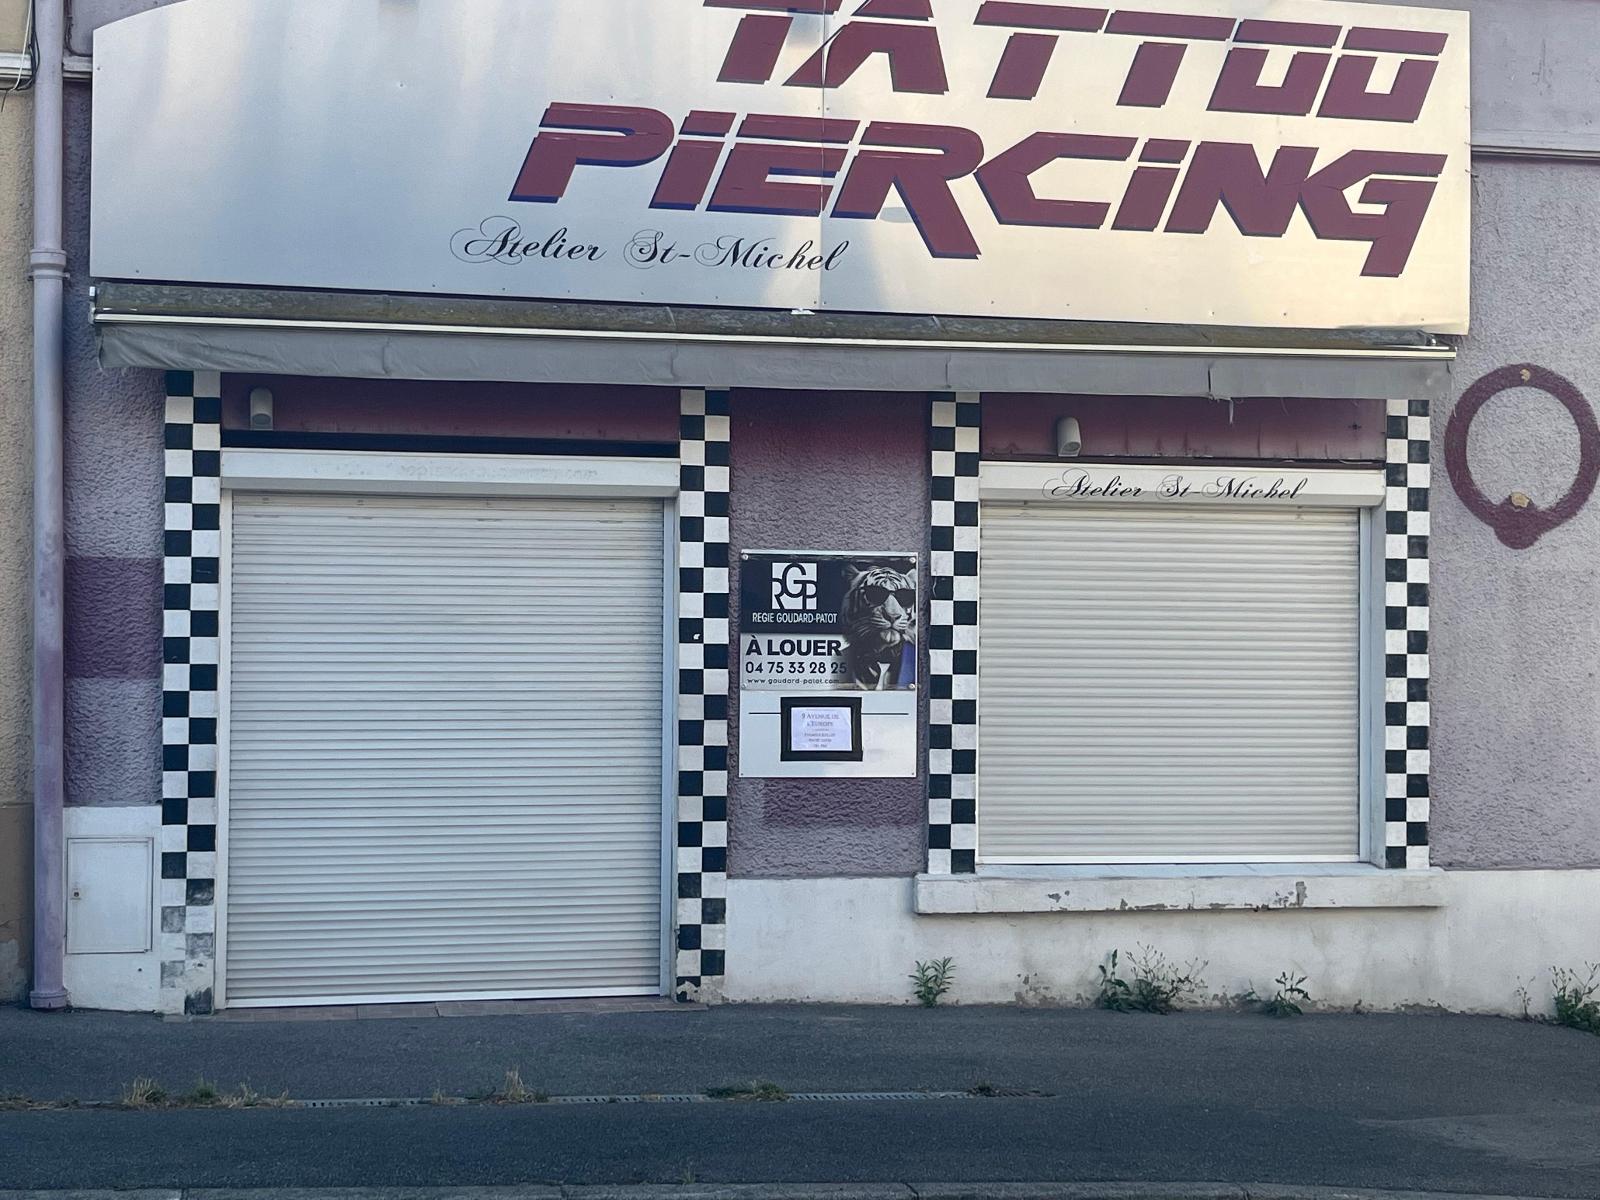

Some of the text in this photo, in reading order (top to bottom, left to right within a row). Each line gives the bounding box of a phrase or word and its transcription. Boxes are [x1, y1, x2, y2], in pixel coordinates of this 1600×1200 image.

[450, 215, 852, 271] Atelier St-Michel
[1042, 468, 1308, 500] Atelier St-Michel
[752, 612, 837, 623] REGIE GOUDARD-PATOT
[745, 634, 842, 656] À LOUER
[745, 661, 847, 674] 04 75 33 28 25
